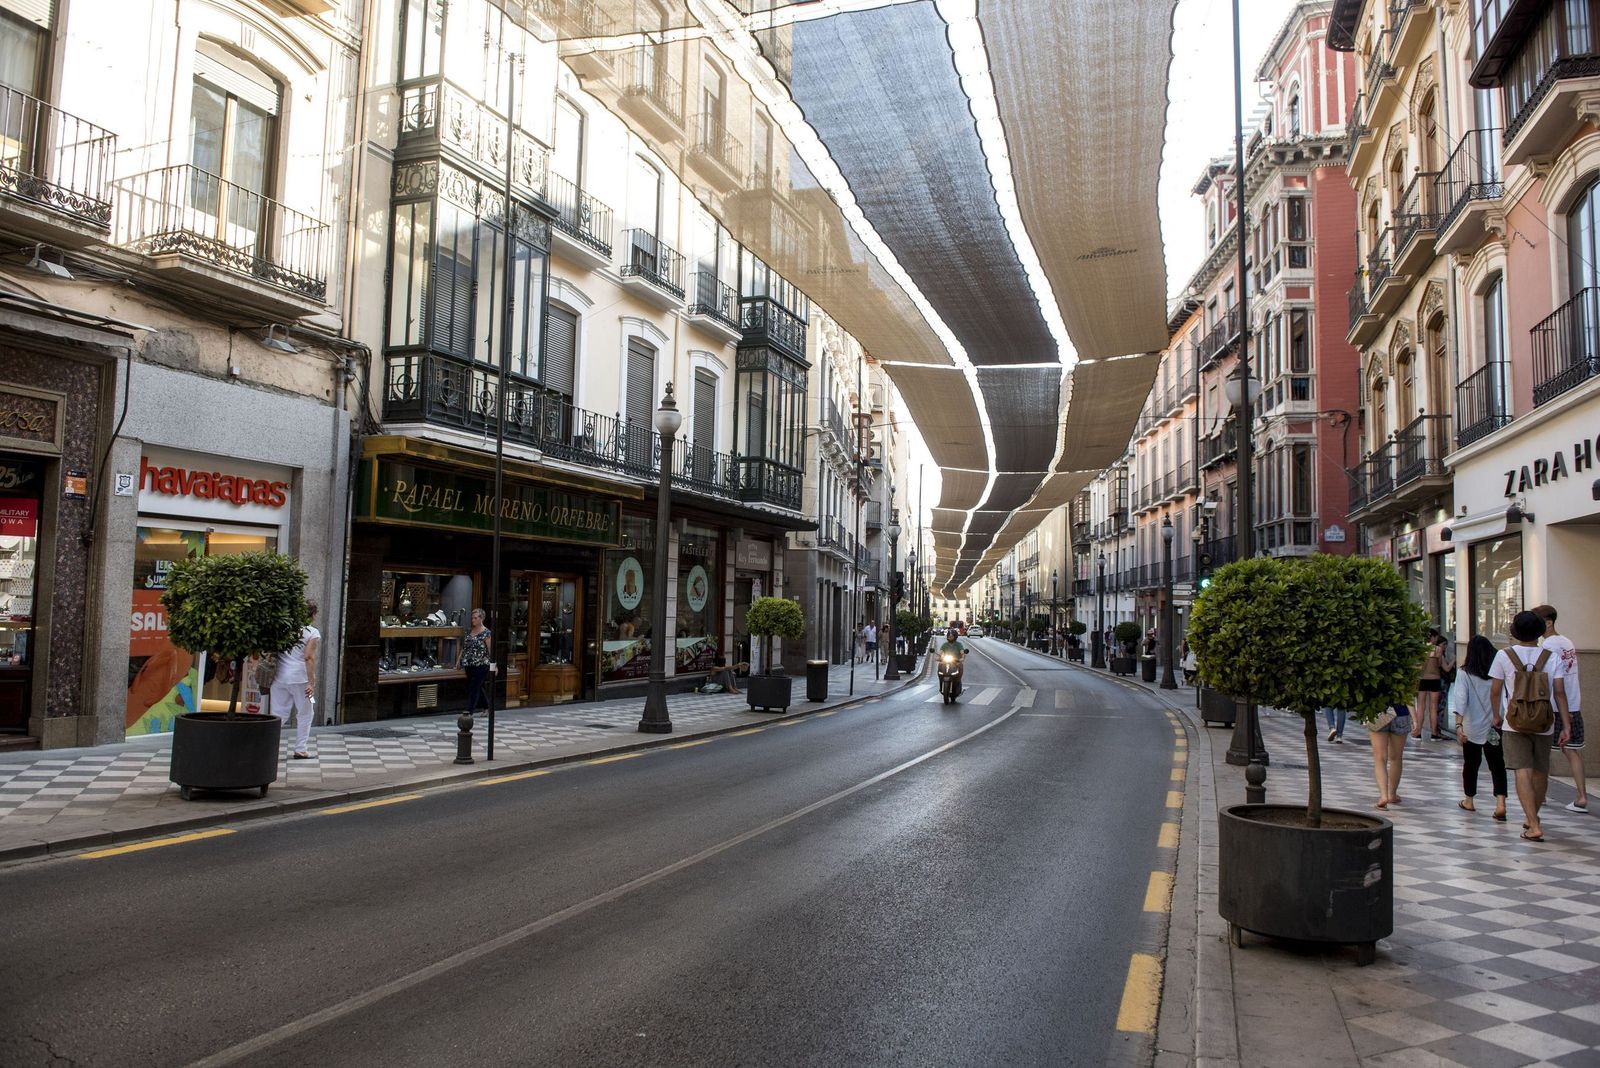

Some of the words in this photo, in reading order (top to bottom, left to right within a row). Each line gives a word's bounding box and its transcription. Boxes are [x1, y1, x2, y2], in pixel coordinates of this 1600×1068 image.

[139, 456, 286, 507] havaianas
[1504, 451, 1568, 497] ZARA
[1574, 432, 1600, 472] H
[393, 480, 464, 512] RAFAEL
[551, 505, 608, 531] ORFEBRE
[145, 575, 168, 588] SUM
[131, 612, 169, 631] SAL
